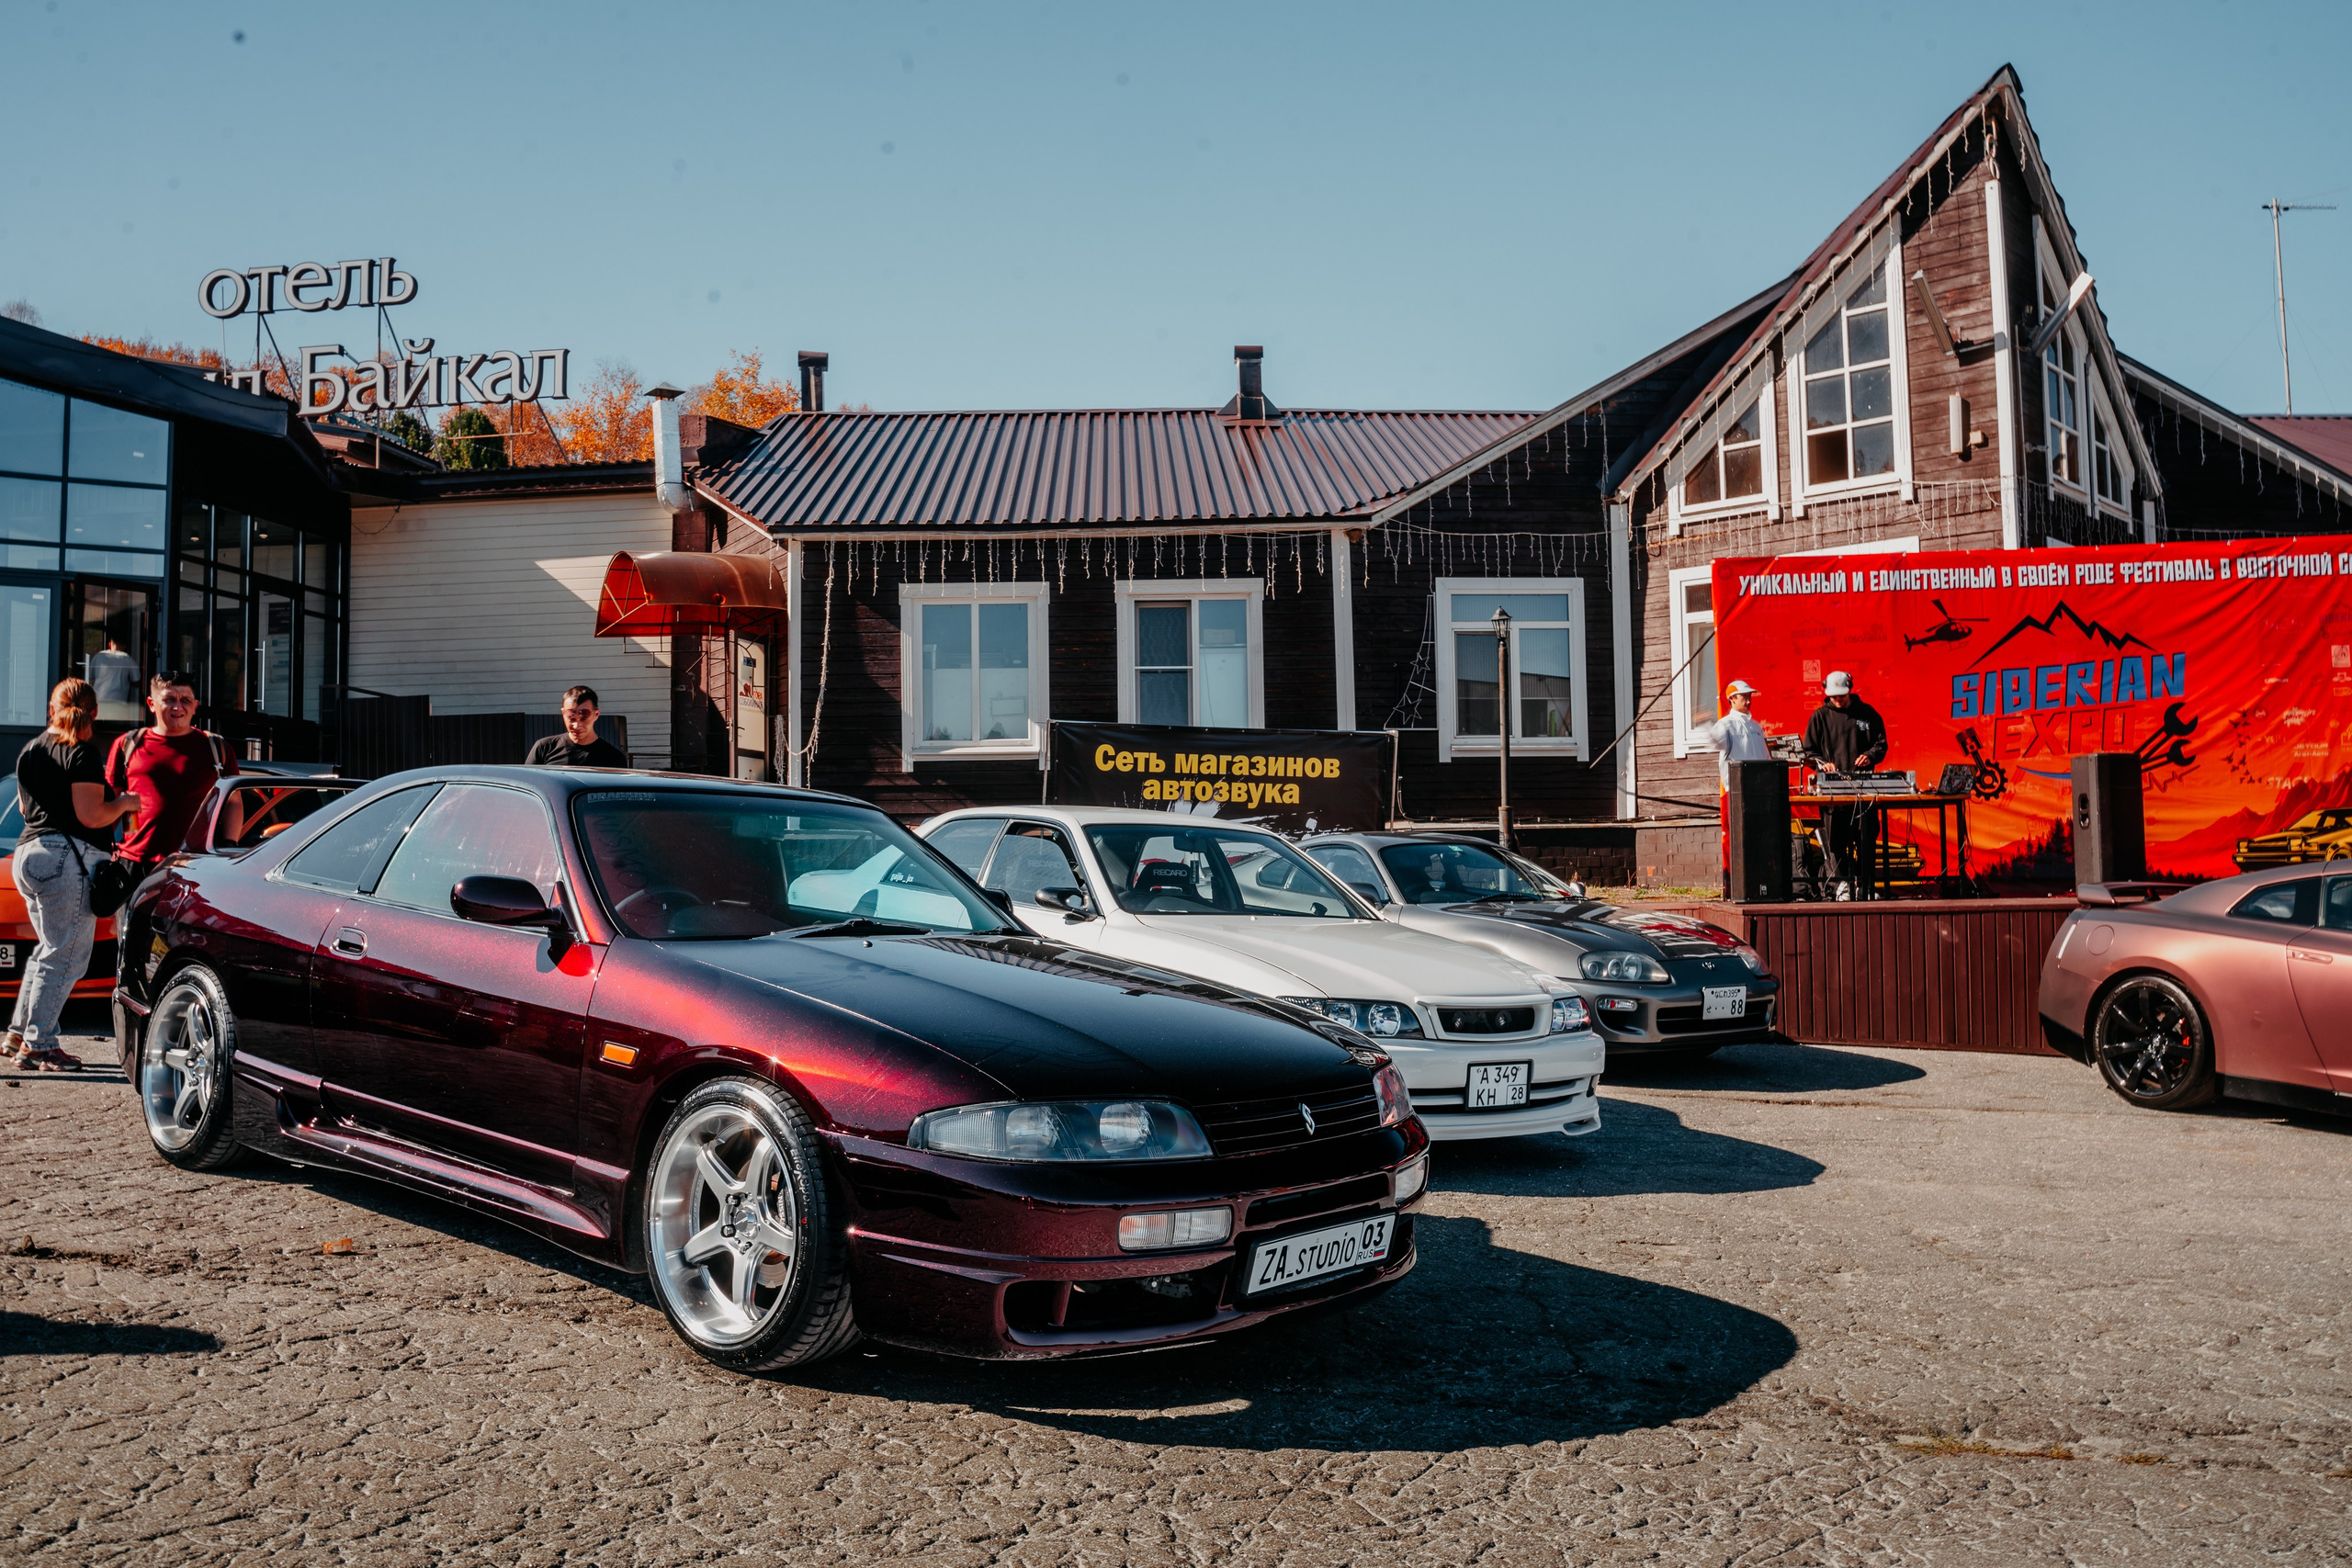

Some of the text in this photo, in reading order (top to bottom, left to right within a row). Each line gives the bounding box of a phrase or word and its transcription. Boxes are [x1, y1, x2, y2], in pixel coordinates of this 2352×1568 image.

[198, 257, 418, 319] отель
[297, 338, 571, 418] Байкал
[1738, 570, 1847, 596] УНИКАЛЬНЫЙ
[1852, 571, 1864, 592] И
[1870, 565, 1996, 592] ЕДИНСТВЕННЫЙ
[2001, 566, 2012, 587] В
[2075, 563, 2114, 586] РОДЕ
[2120, 558, 2215, 583] ФЕСТИВАЛЬ
[2220, 558, 2231, 580] В
[2236, 552, 2333, 579] ВОСТОЧНОЙ
[1951, 651, 2186, 719] SIBERIAN
[1994, 705, 2136, 761] EXPO
[1094, 743, 1341, 779] Сеть магазинов
[1142, 778, 1300, 810] автозвука
[1152, 869, 1188, 877] RECARO
[1730, 999, 1744, 1015] 88
[1494, 1066, 1519, 1084] 349
[1511, 1087, 1524, 1100] 28
[1362, 1221, 1386, 1249] 03
[1357, 1250, 1374, 1260] RUS
